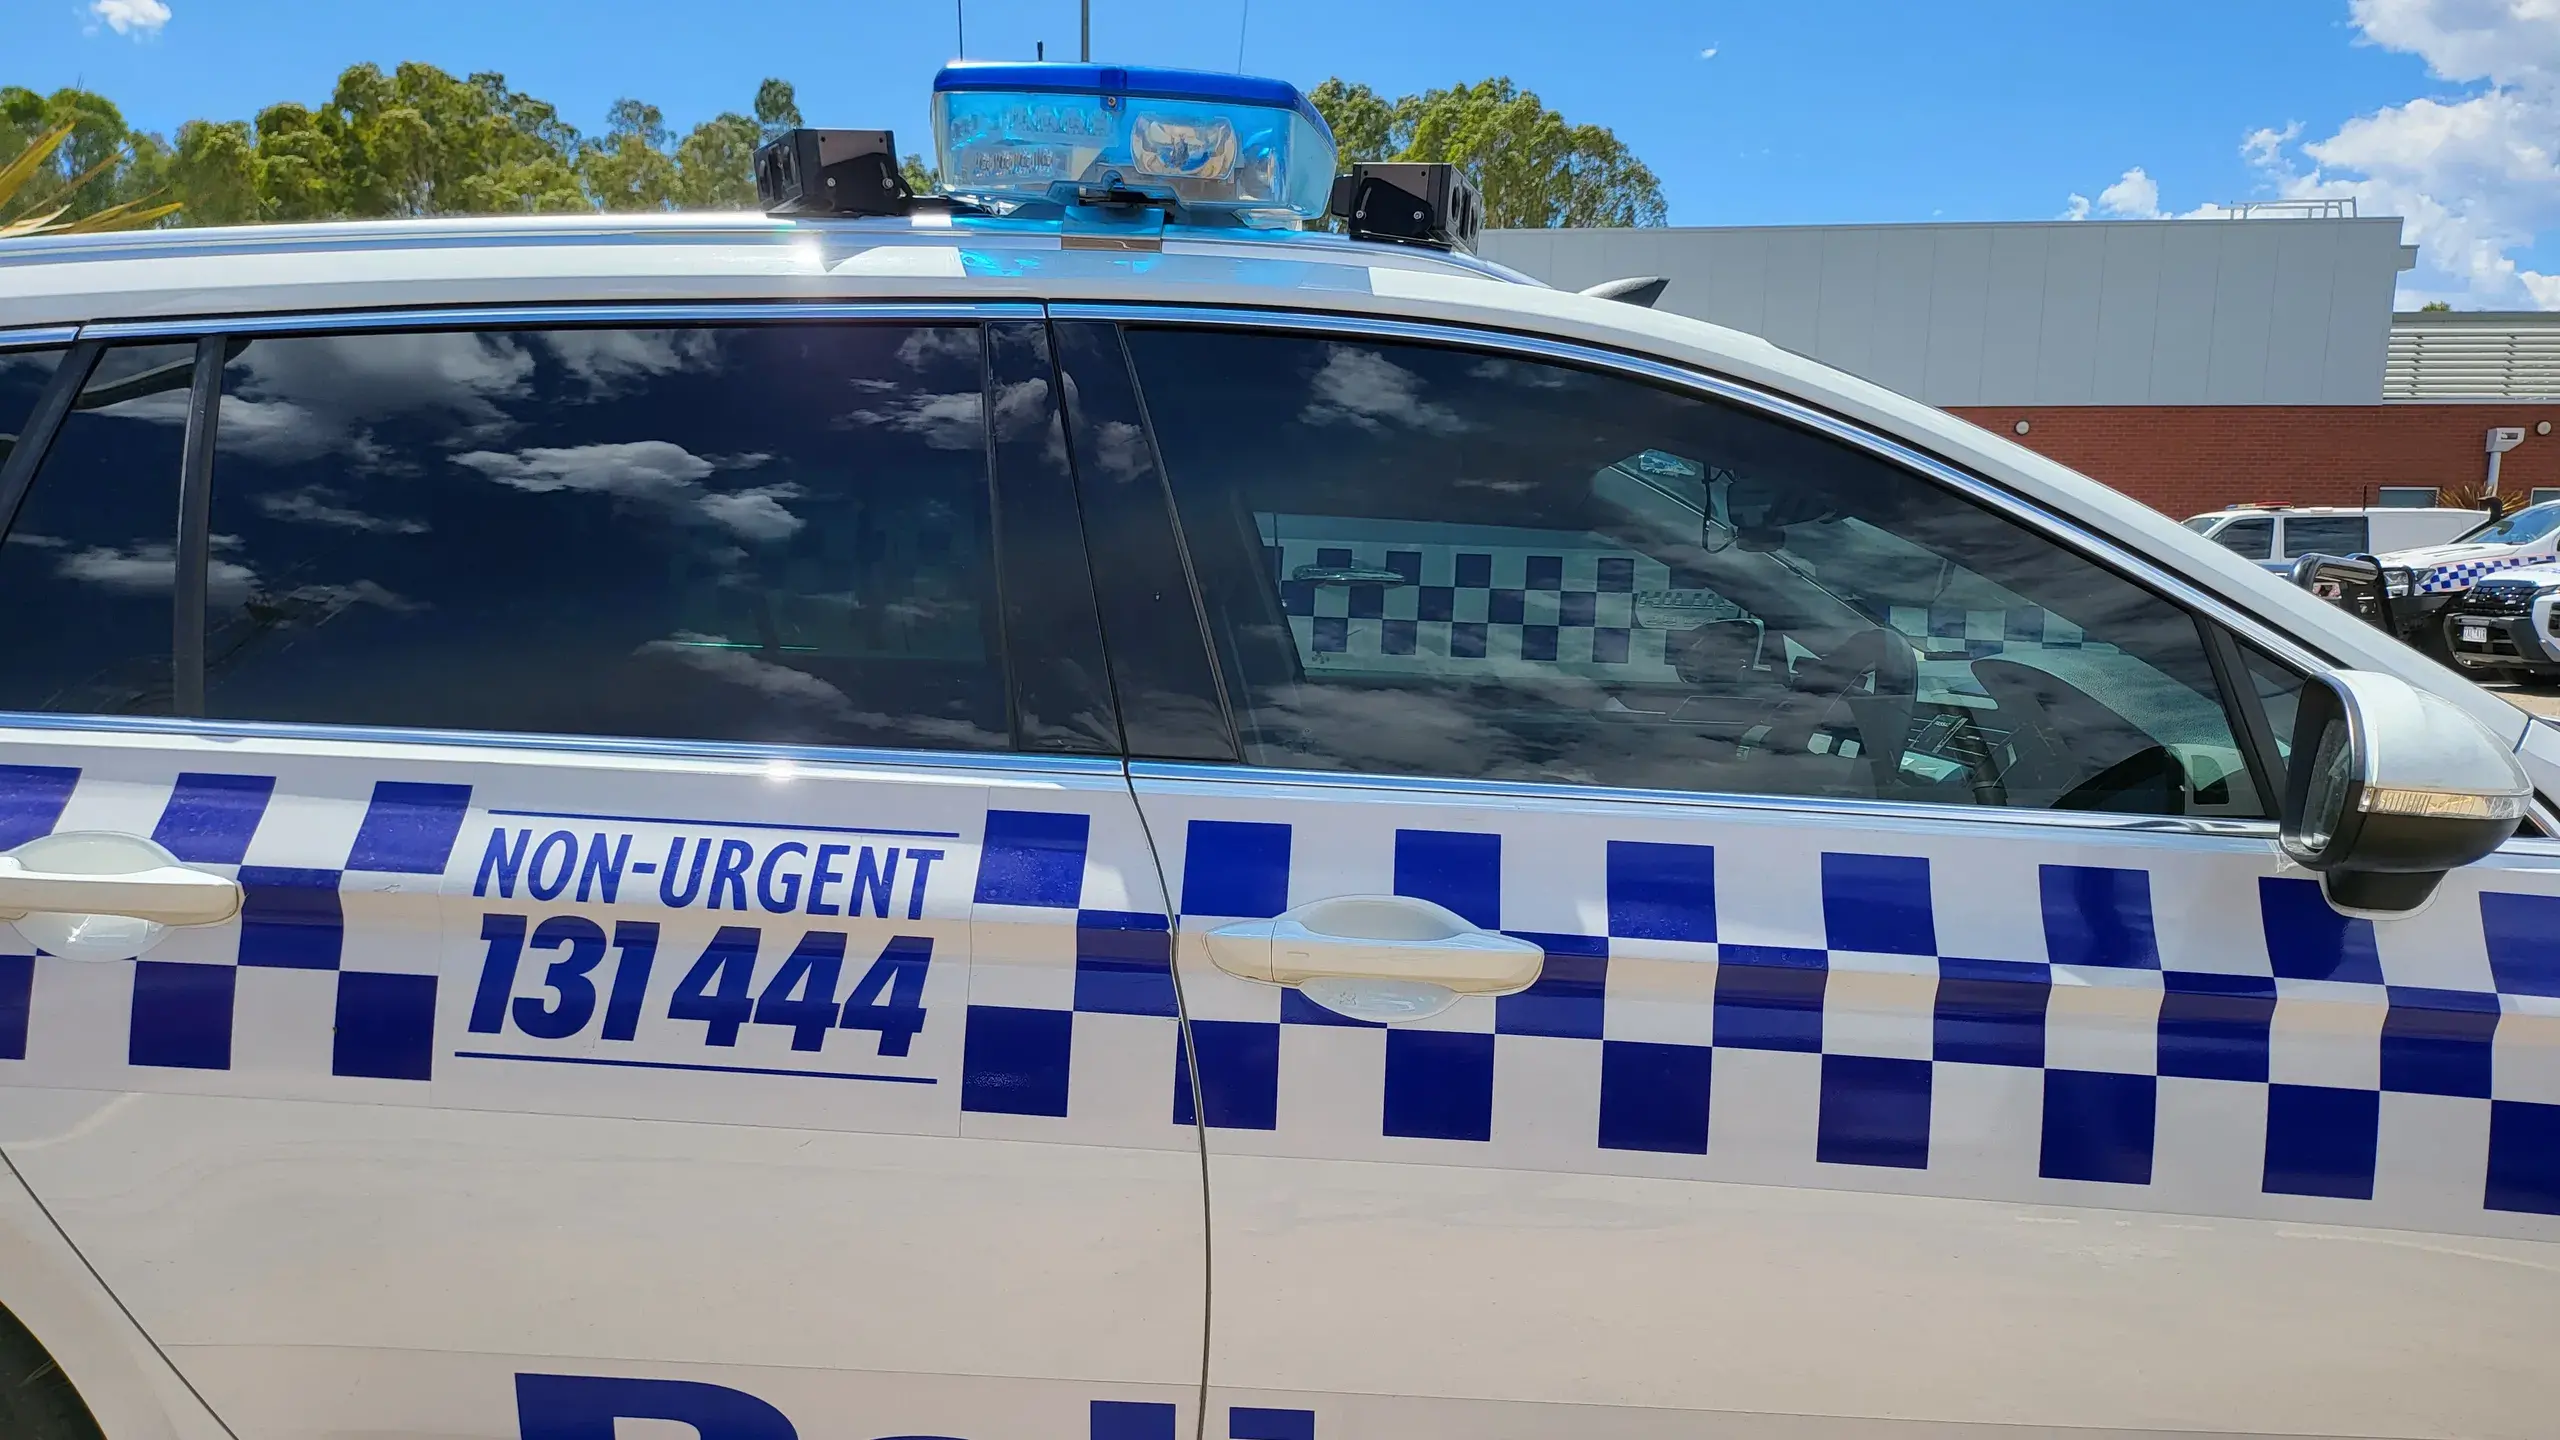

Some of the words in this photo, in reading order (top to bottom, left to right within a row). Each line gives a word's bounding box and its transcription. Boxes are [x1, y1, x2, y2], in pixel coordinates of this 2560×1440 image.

[473, 827, 945, 920] NON-URGENT
[468, 913, 660, 1041] 131
[667, 925, 934, 1057] 444
